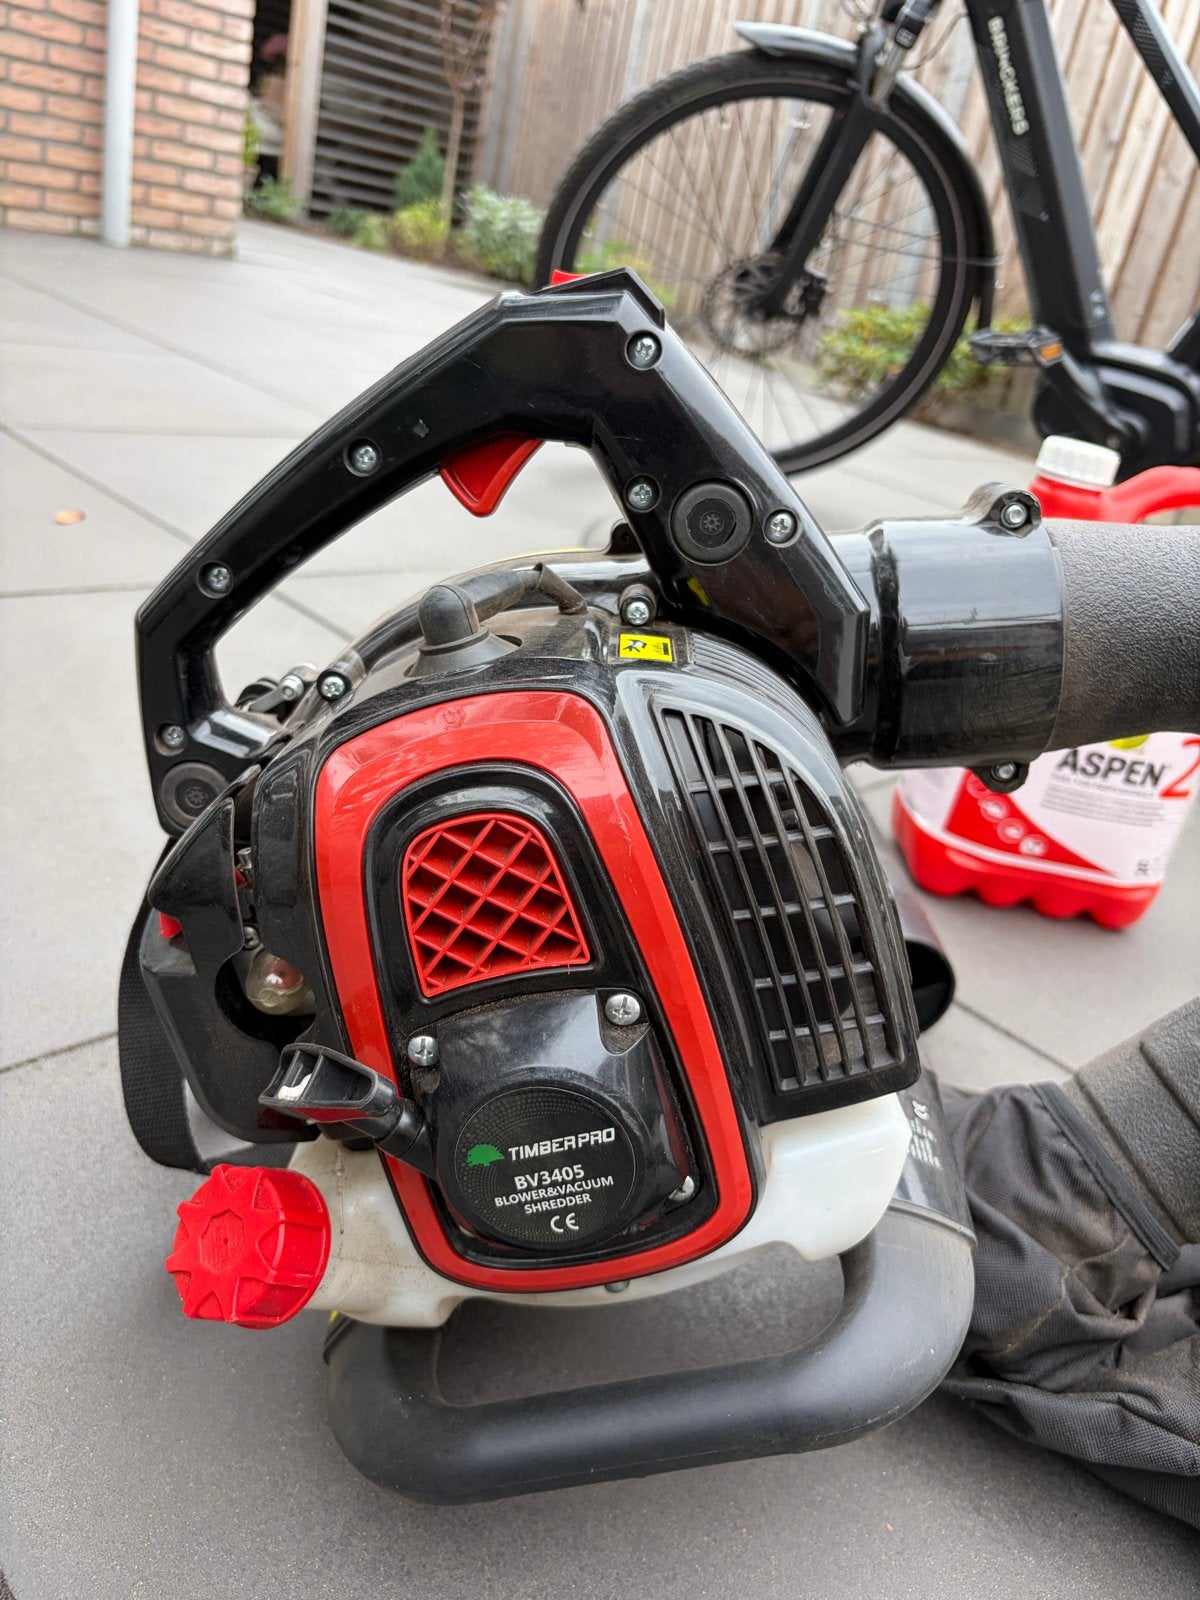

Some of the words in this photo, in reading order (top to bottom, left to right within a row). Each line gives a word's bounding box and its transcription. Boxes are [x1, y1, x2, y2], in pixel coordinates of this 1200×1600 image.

[1057, 748, 1165, 788] ASPEN
[1158, 737, 1200, 800] 2
[508, 1127, 616, 1162] TIMBERPRO
[494, 1175, 614, 1207] BLOWER&VACUUM
[514, 1164, 585, 1190] BV3405
[524, 1193, 592, 1214] SHREDDER
[550, 1212, 579, 1233] CE
